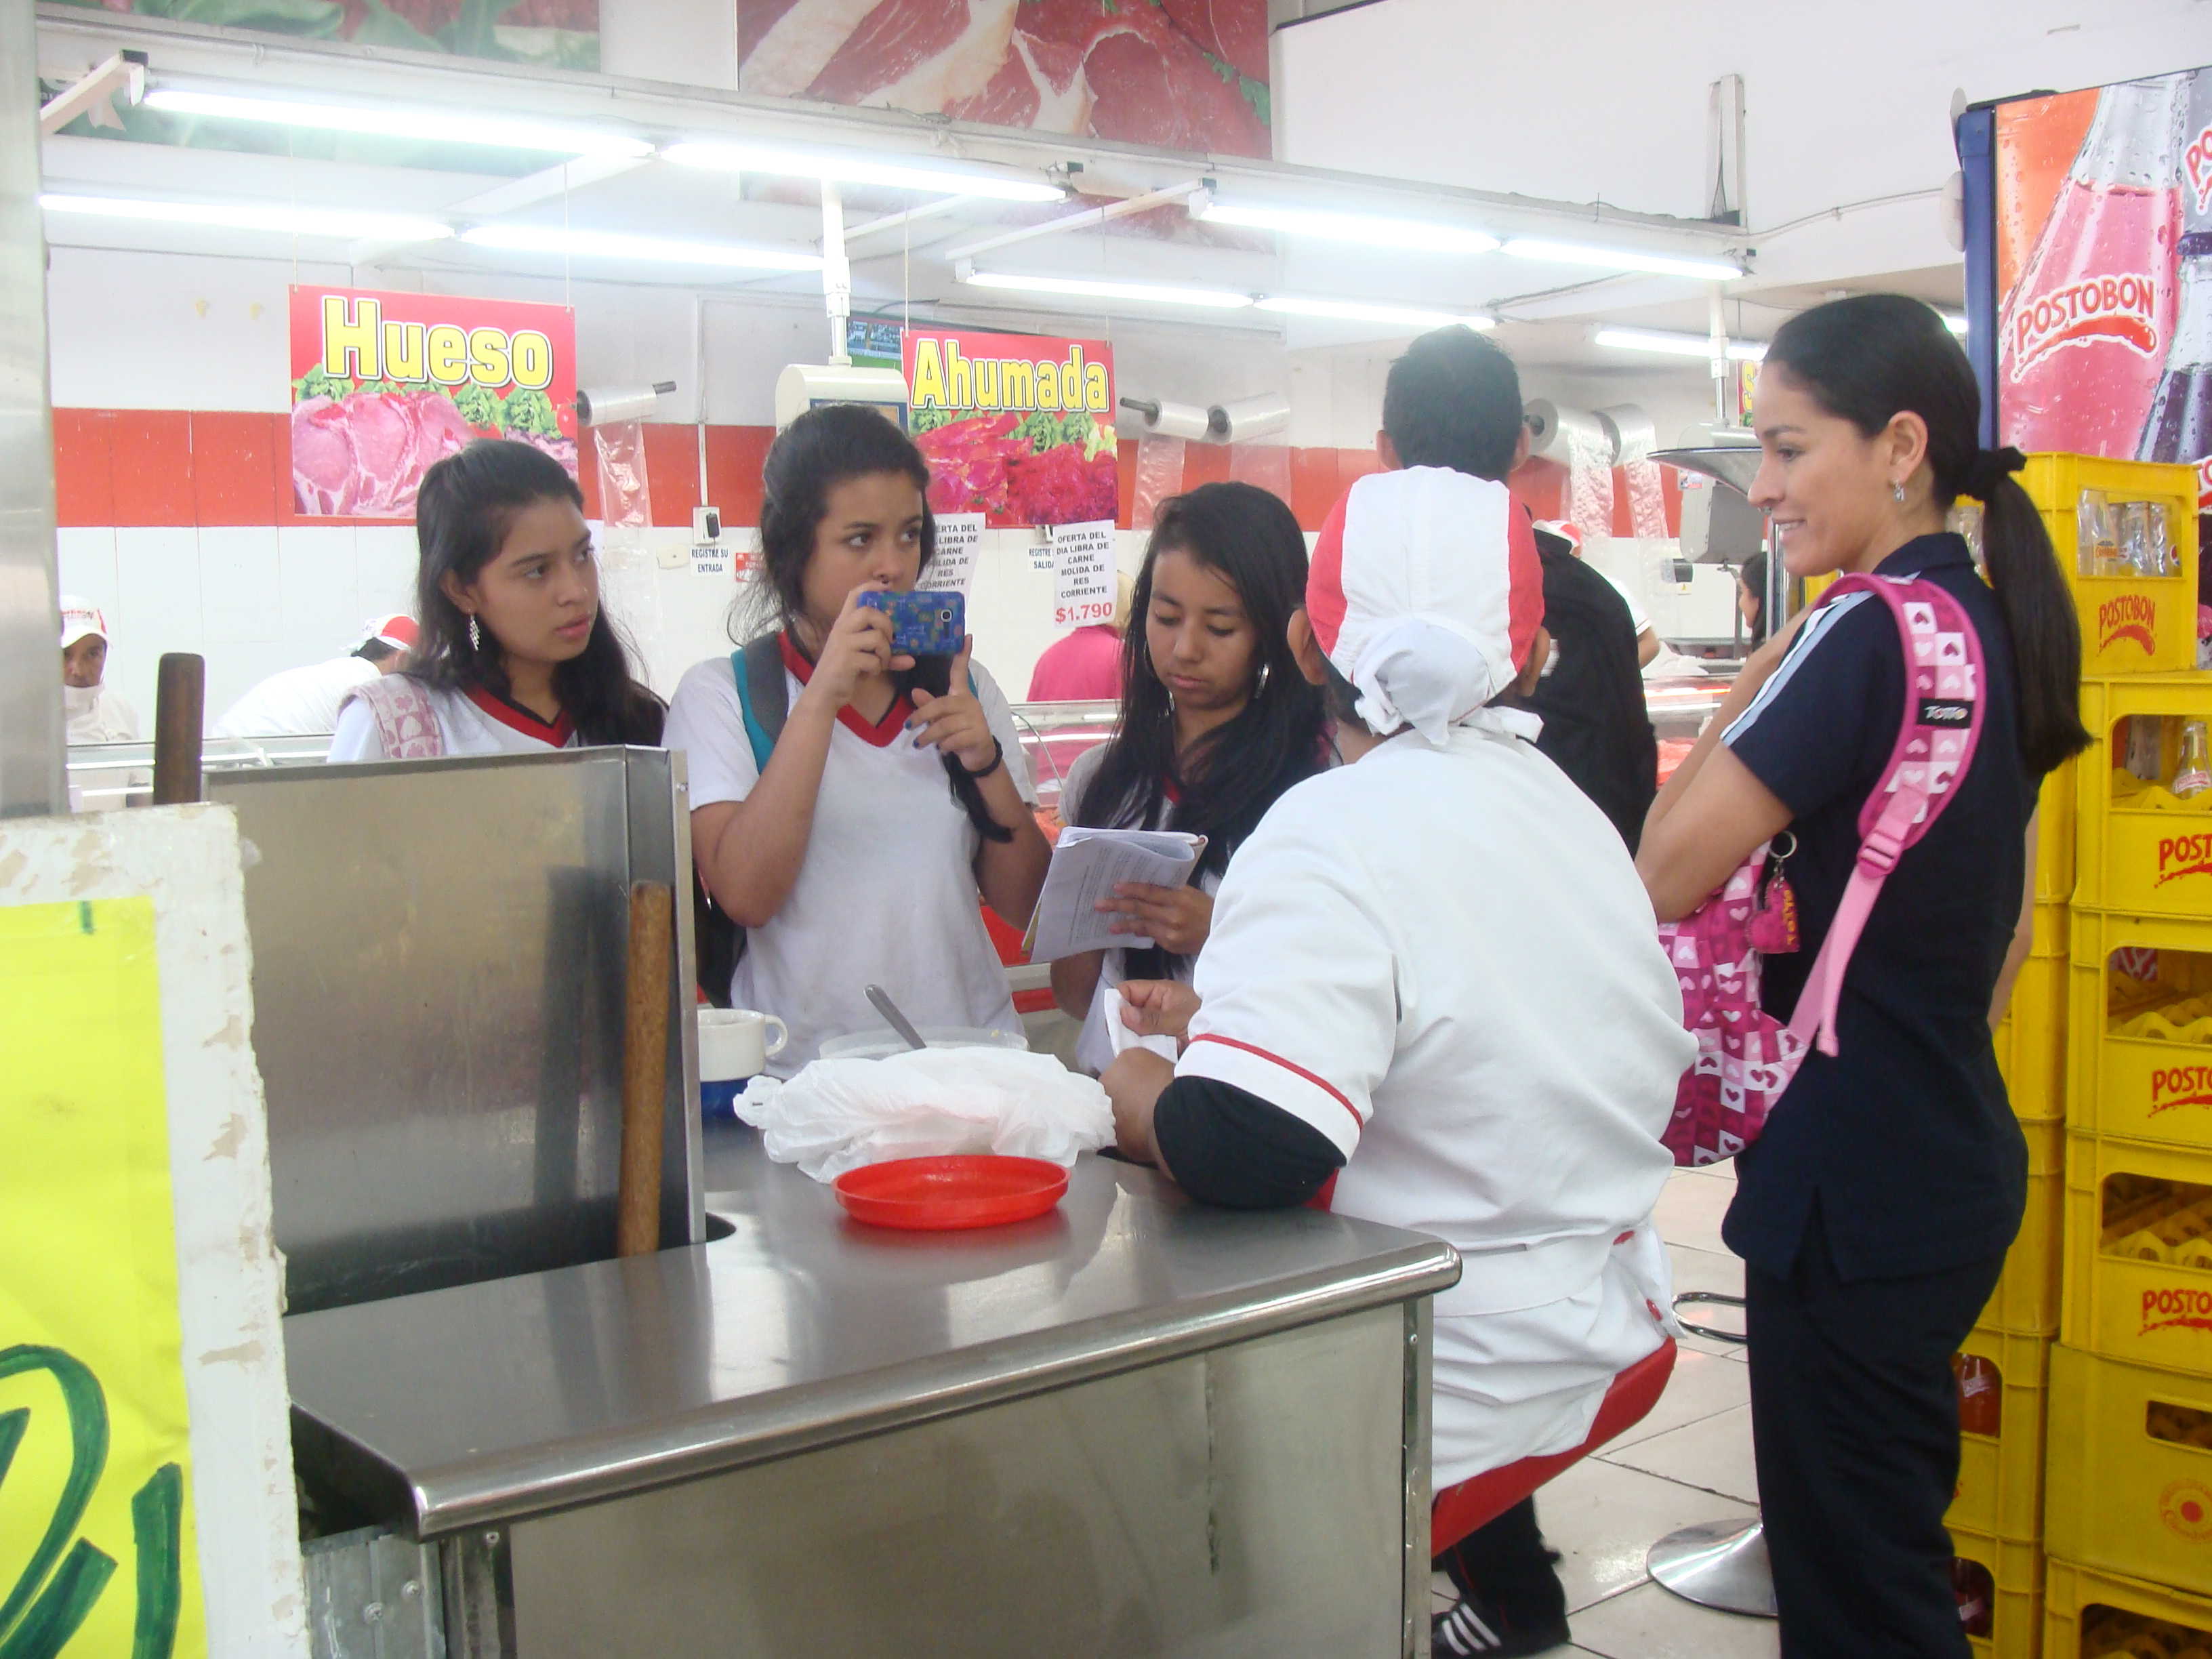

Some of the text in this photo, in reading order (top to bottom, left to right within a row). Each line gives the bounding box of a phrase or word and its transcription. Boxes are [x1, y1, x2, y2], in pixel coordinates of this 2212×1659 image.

[2017, 277, 2154, 354] POSTOBON
[323, 296, 552, 390] Hueso
[912, 339, 1109, 411] Ahumada
[961, 524, 977, 532] DEL
[939, 535, 978, 544] LIBRA DE
[1058, 531, 1106, 544] OFERTA DEL
[691, 548, 729, 558] REGISTRE SU
[1029, 548, 1051, 556] REGISTRE
[1057, 547, 1068, 555] DIA
[1070, 544, 1094, 553] LIBRA
[1068, 554, 1094, 564] CARNE
[698, 564, 723, 573] ENTRADA
[938, 569, 954, 577] RES
[1061, 564, 1105, 576] MOLIDA DE
[1073, 577, 1089, 586] RES
[1061, 586, 1107, 598] CORRIENTE
[1055, 602, 1113, 623] $1.790
[2099, 594, 2155, 638] POSTOBON
[2142, 1289, 2212, 1320] POSTO
